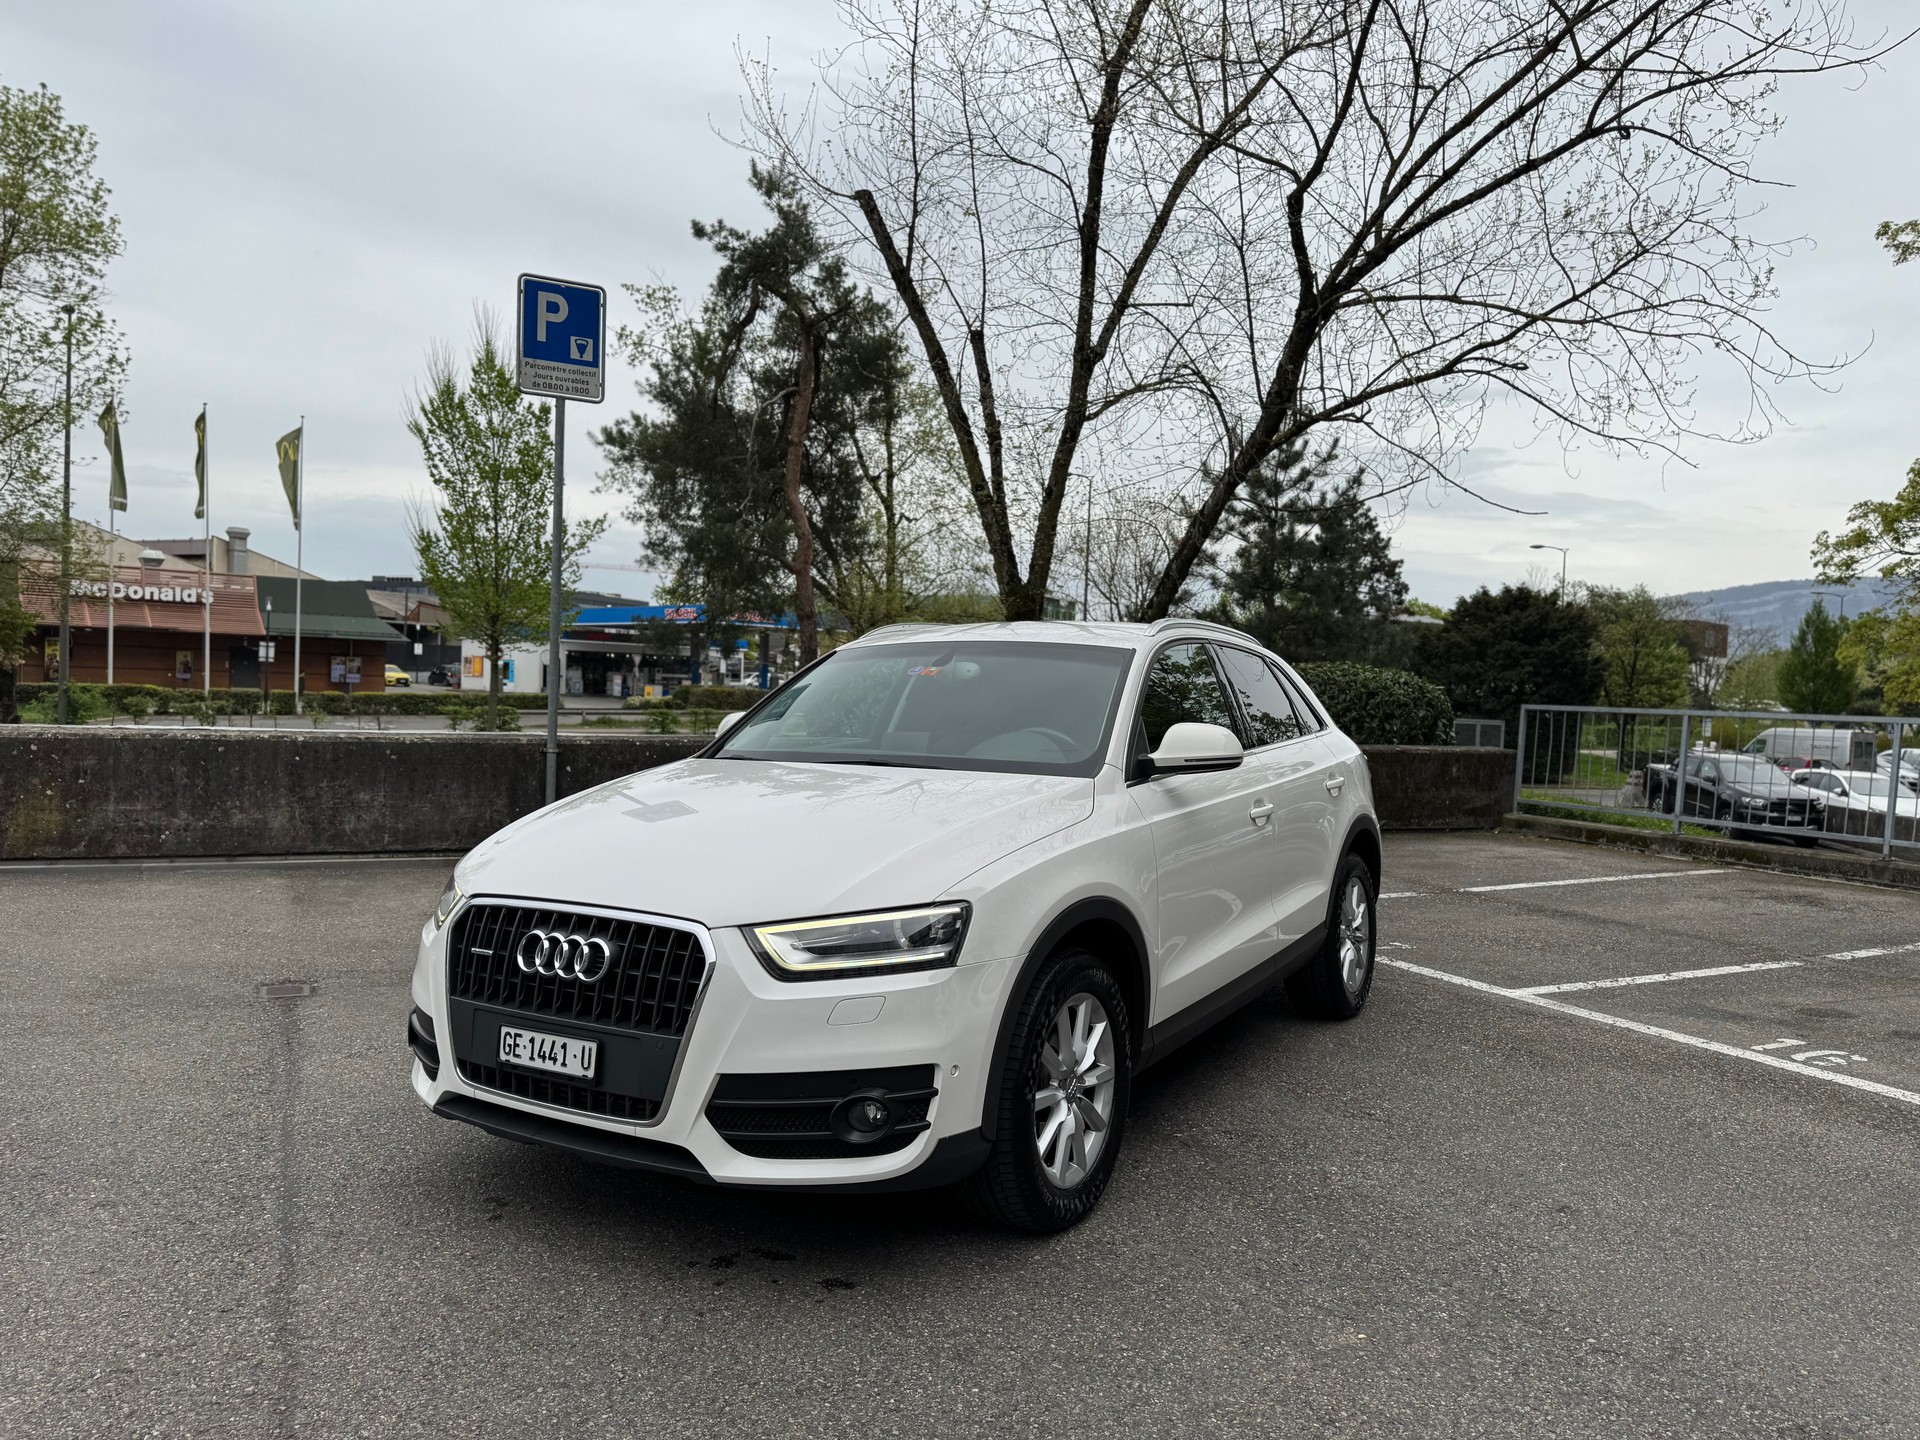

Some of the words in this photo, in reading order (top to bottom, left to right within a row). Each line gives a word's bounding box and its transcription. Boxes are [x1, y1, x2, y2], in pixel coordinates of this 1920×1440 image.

[537, 290, 569, 342] P
[524, 361, 567, 373] Parcomètre
[568, 368, 597, 378] collectif
[533, 371, 554, 381] Jours
[555, 375, 590, 386] ouvrables
[1751, 1038, 1868, 1066] 16
